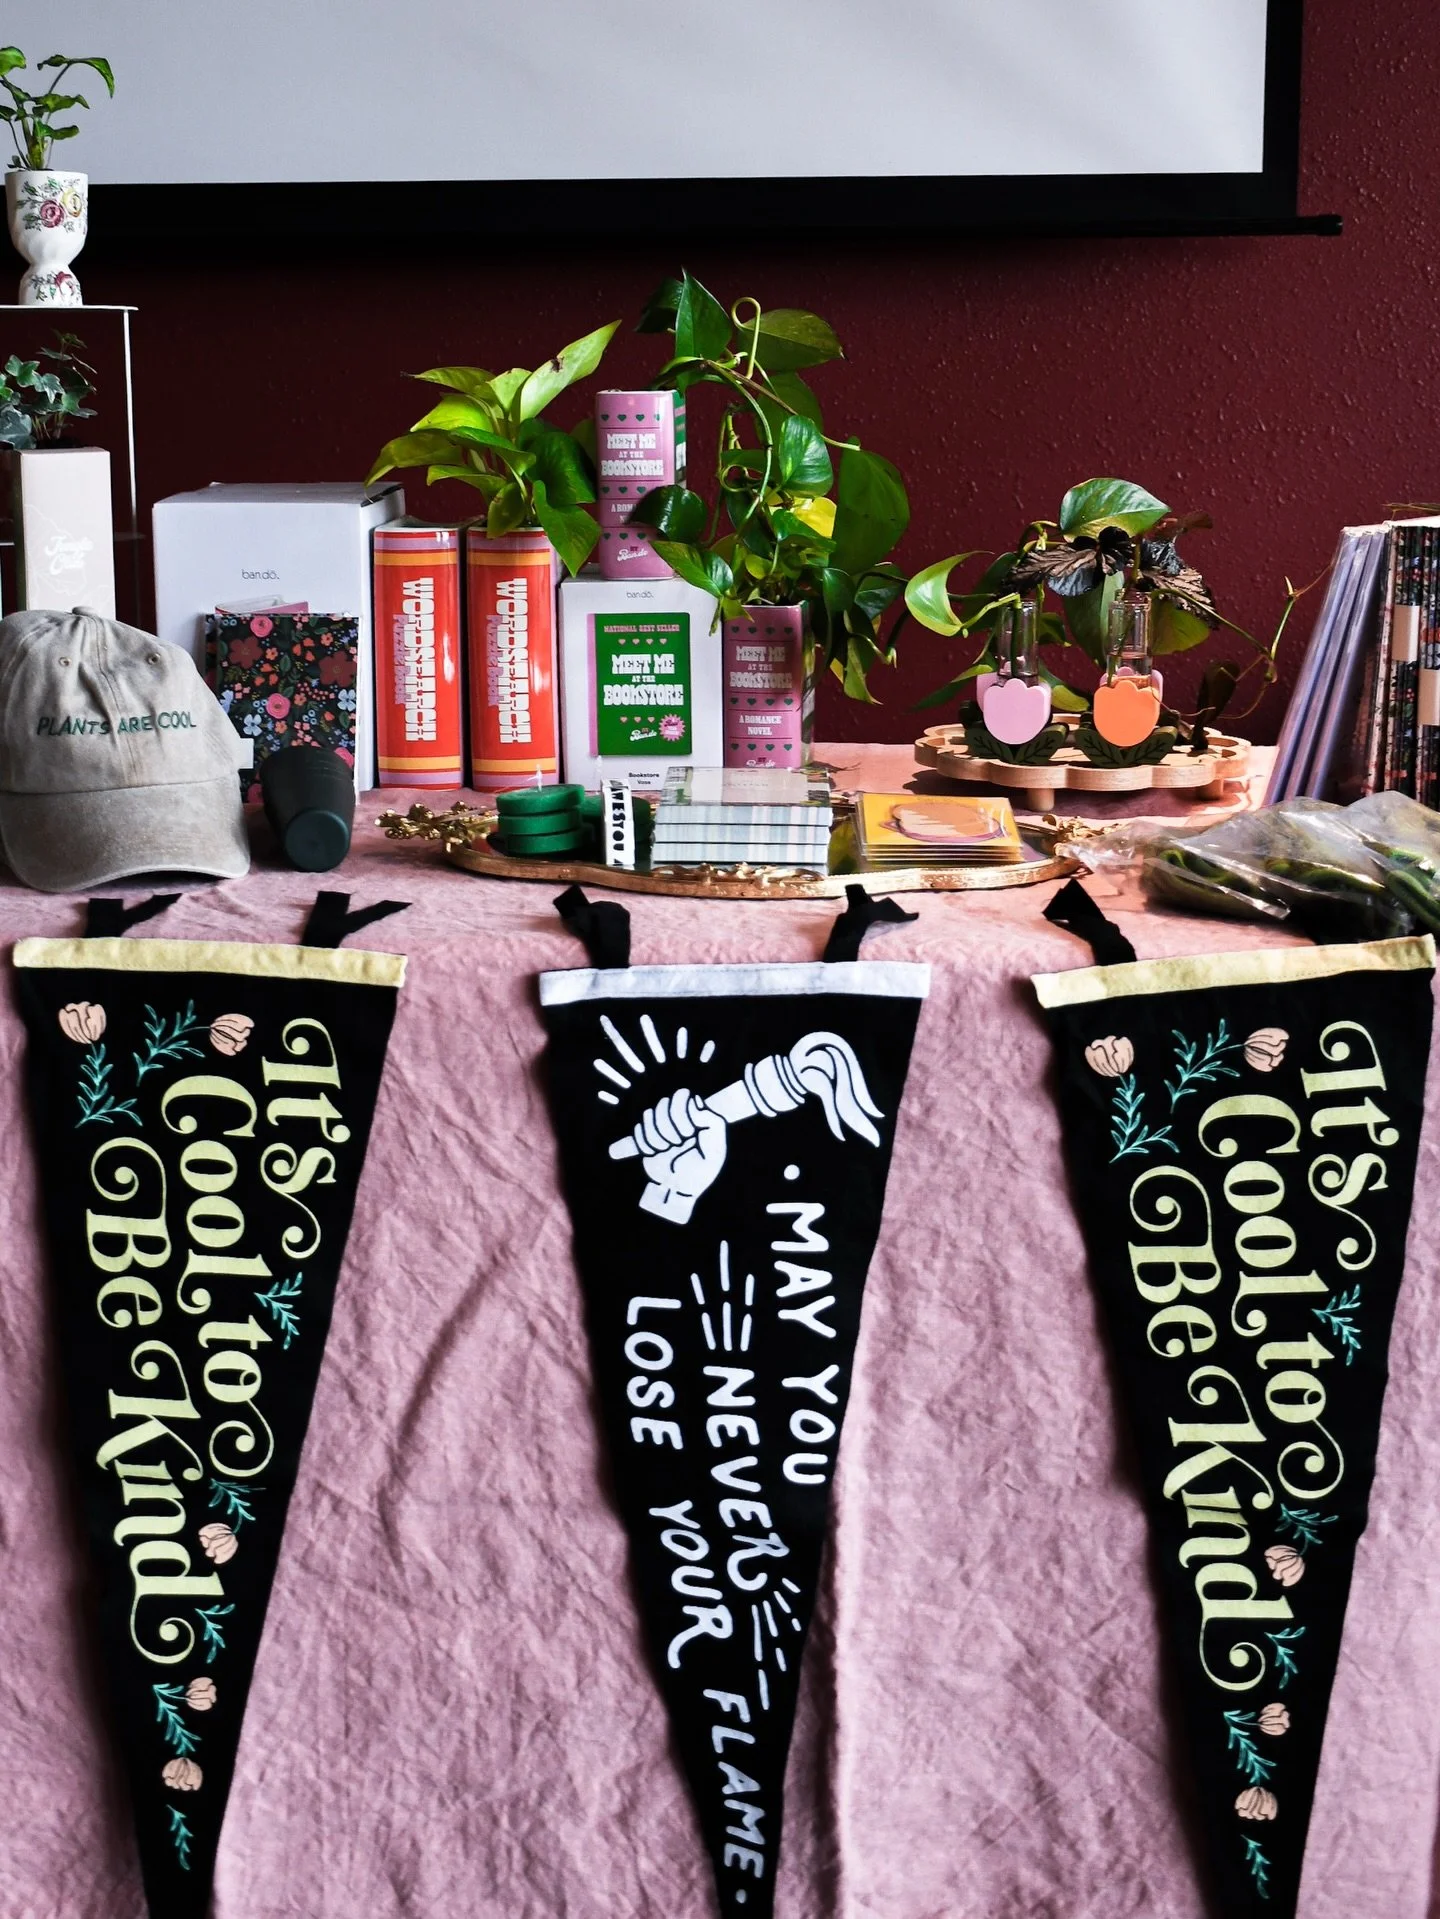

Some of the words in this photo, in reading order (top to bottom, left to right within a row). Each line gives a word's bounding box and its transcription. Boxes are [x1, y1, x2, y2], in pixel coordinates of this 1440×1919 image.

[601, 460, 664, 476] BOOKSTORE
[607, 434, 637, 449] MEET
[639, 434, 656, 449] ME
[619, 451, 628, 459] AT
[630, 451, 644, 459] THE
[603, 684, 684, 706] BOOKSTORE
[612, 654, 651, 674] MEET
[653, 653, 675, 674] ME
[642, 675, 656, 683] THE
[730, 672, 792, 688] BOOKSTORE
[736, 646, 766, 662] MEET
[768, 646, 785, 662] ME
[744, 715, 782, 724] ROMANCE
[36, 715, 111, 737] PLANTS
[118, 715, 153, 734] ARE
[157, 710, 197, 729] COOL
[748, 727, 772, 735] NOVEL
[86, 1137, 172, 1328] Be
[161, 1075, 273, 1314] Cool
[1128, 1165, 1222, 1358] Be
[1198, 1094, 1329, 1337] Cool
[766, 1202, 837, 1338] MAY
[199, 1315, 274, 1477] to
[624, 1296, 684, 1450] LOSE
[781, 1364, 840, 1484] YOU
[1256, 1332, 1344, 1499] to
[96, 1340, 225, 1664] Kind
[703, 1365, 790, 1591] NEVER
[1163, 1365, 1295, 1691] Kind
[649, 1500, 733, 1669] YOUR
[703, 1688, 766, 1878] FLAME
